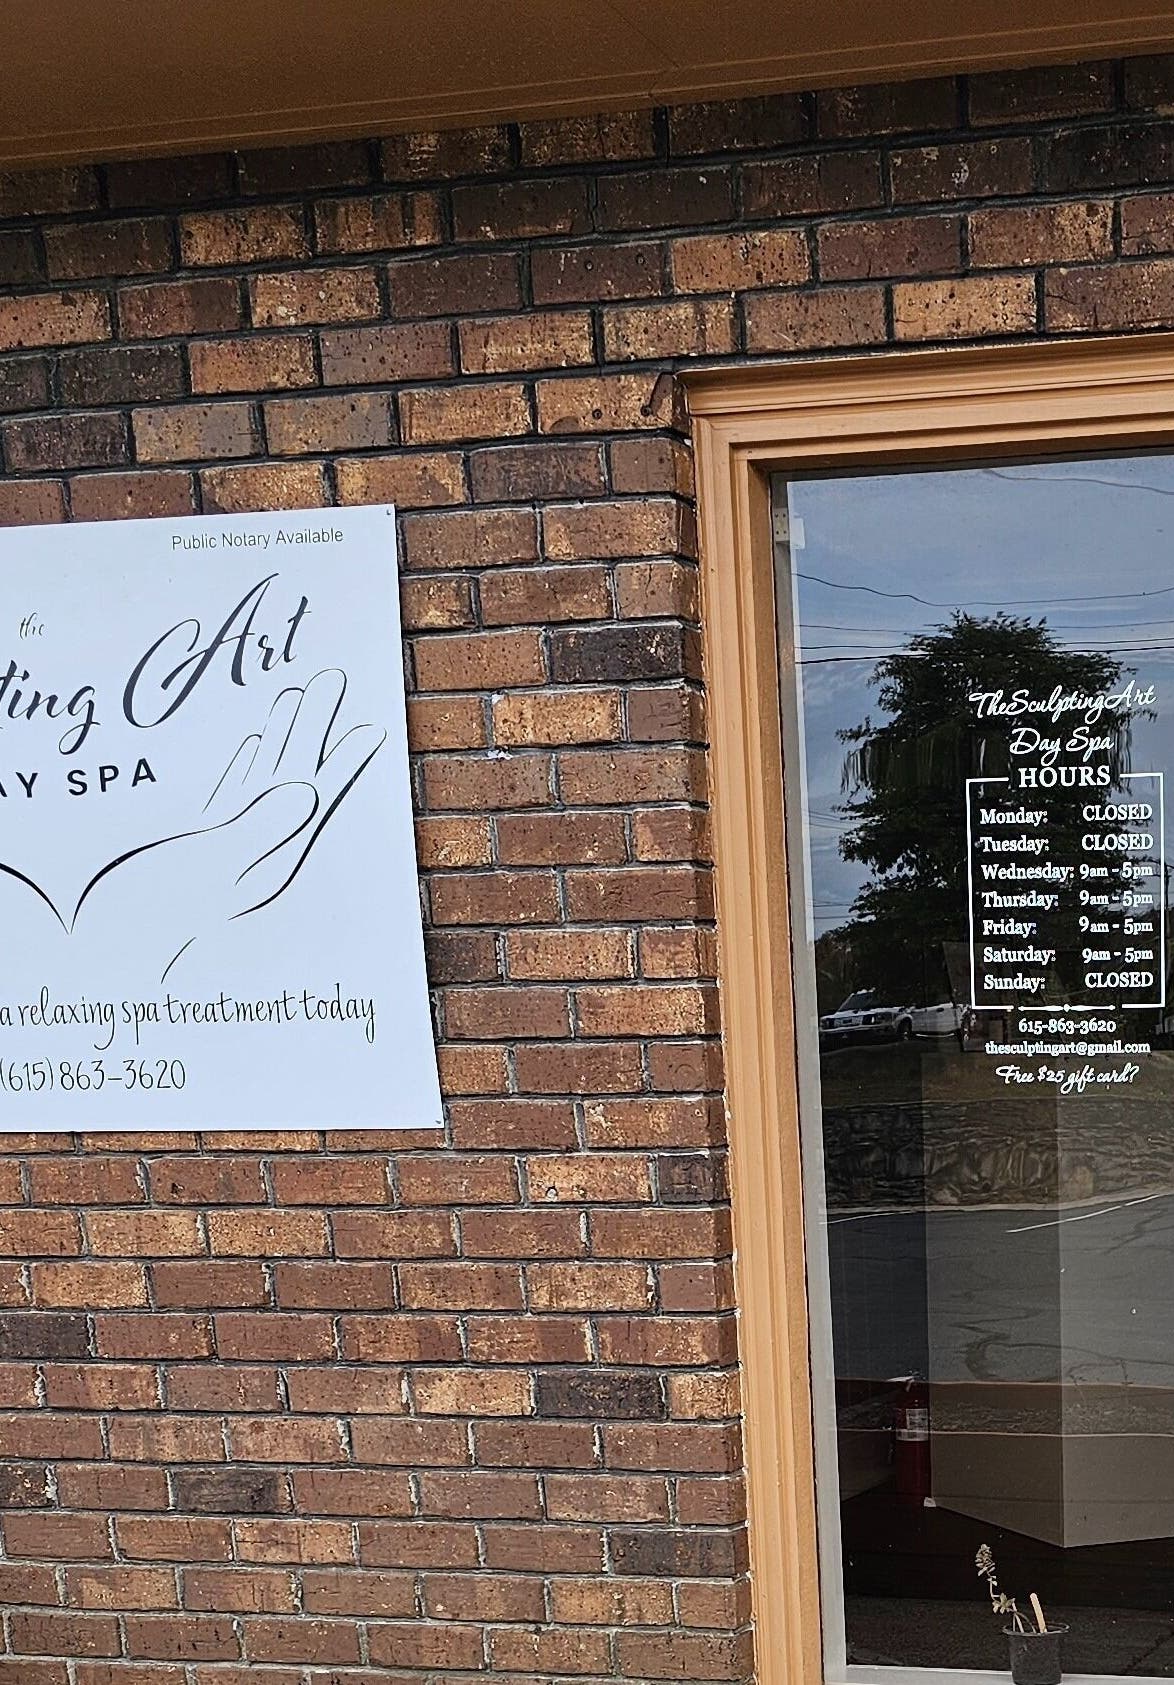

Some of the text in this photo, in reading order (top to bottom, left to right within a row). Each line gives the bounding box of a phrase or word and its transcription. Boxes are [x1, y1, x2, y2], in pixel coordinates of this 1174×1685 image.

[172, 528, 344, 550] Public Notary Available
[19, 611, 45, 639] the
[123, 573, 311, 728] Art
[1010, 727, 1114, 766] Day Spa
[0, 757, 157, 798] Y SPA
[1018, 765, 1110, 787] HOURS
[980, 804, 1152, 826] Monday: CLOSED
[980, 834, 1153, 854] Tuesday: CLOSED
[981, 862, 1074, 882] Wednesday:
[1080, 864, 1108, 881] 9am
[1121, 863, 1153, 881] 5pm
[982, 891, 1058, 910] Thursday:
[1080, 890, 1109, 905] 9am
[1123, 891, 1153, 907] 5pm
[982, 919, 1037, 938] Friday:
[1079, 916, 1109, 933] 9am
[1123, 919, 1153, 935] 5pm
[984, 946, 1056, 965] Saturday:
[1082, 949, 1111, 963] 9am
[1124, 948, 1153, 963] 5pm
[984, 972, 1153, 993] Sunday: CLOSED
[0, 983, 375, 1050] a relaxing spa treatment today
[1018, 1019, 1116, 1035] 615-863-3620
[985, 1040, 1150, 1056] thesculptingart@gmail.com
[996, 1063, 1139, 1094] Free $25 gift card?
